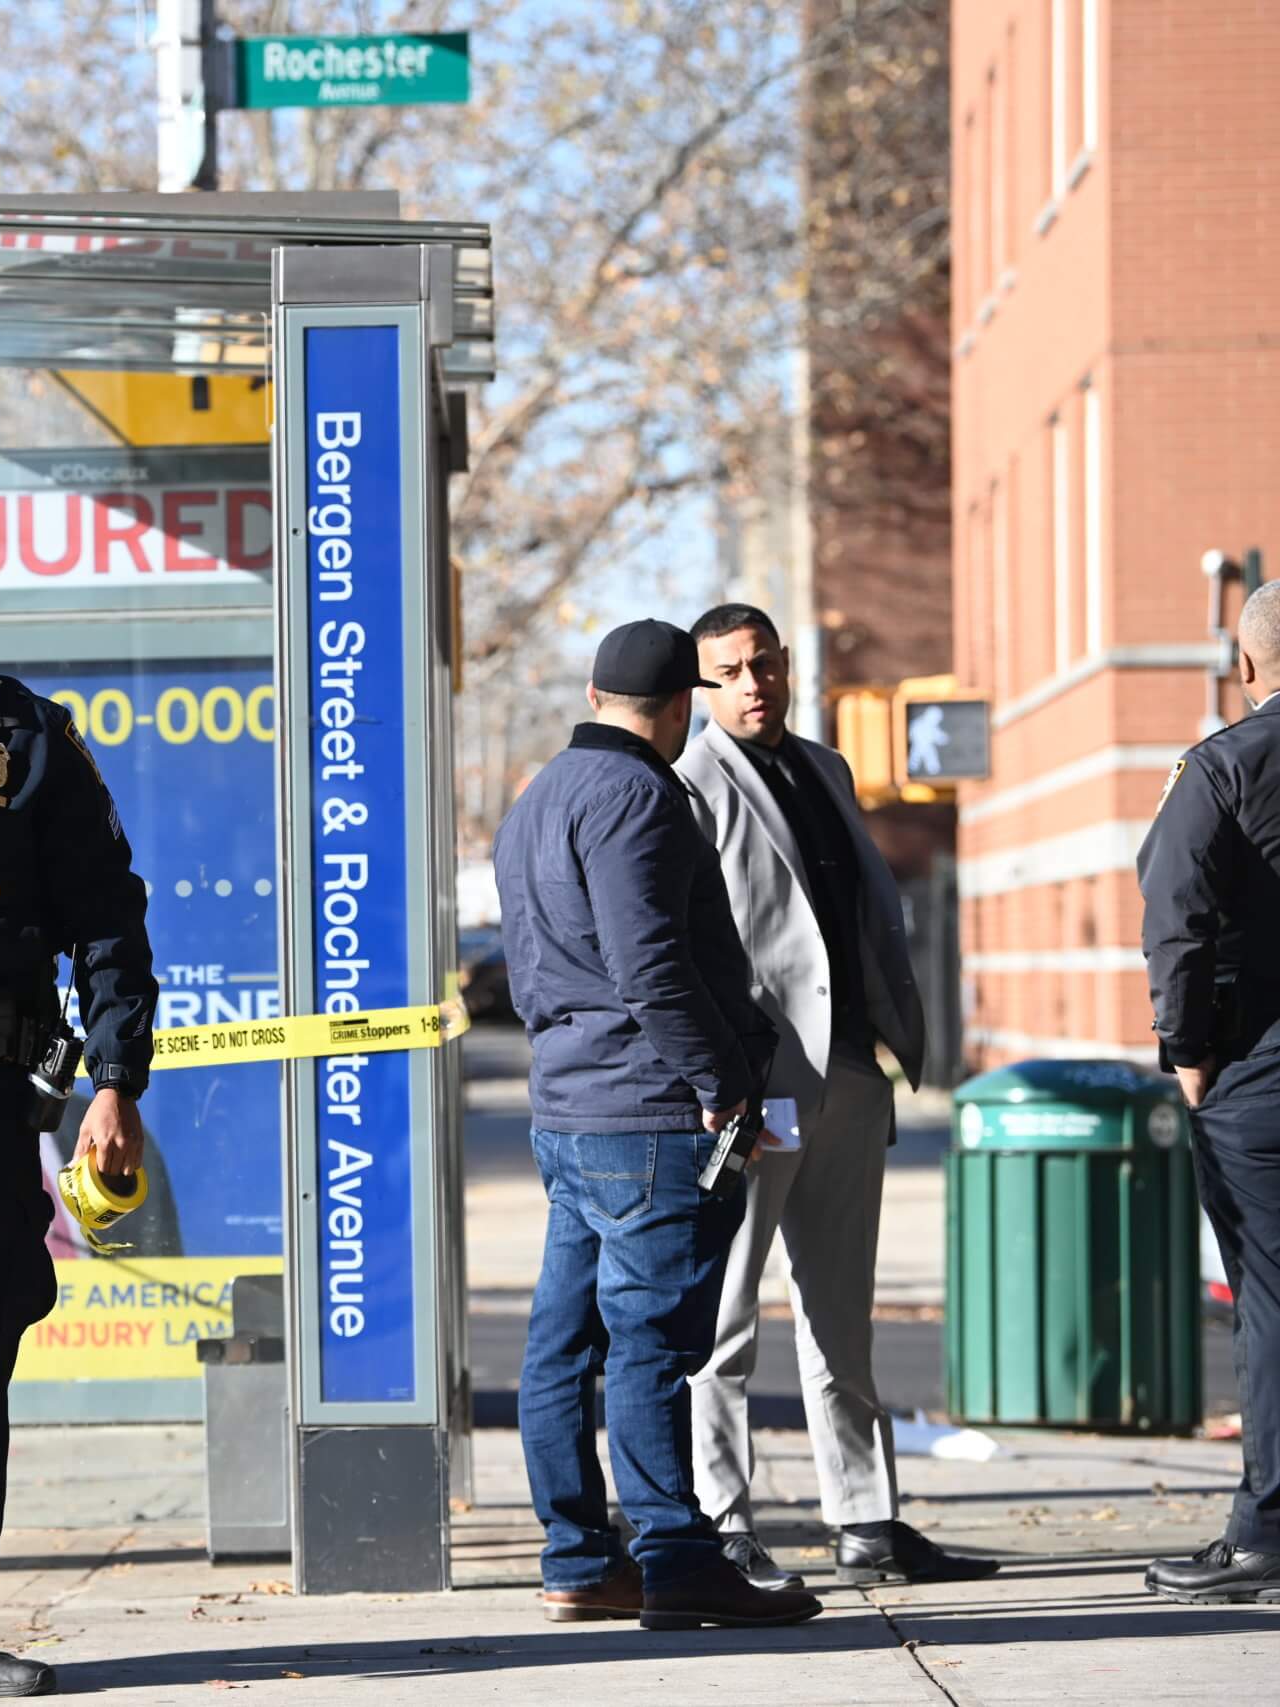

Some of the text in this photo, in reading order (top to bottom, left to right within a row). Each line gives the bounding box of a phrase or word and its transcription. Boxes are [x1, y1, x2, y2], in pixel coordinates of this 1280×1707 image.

[263, 40, 434, 81] Rochester
[308, 411, 374, 1338] Bergen Street & Rocheter Avenue
[166, 964, 225, 985] THE
[167, 1034, 200, 1054] SCENE
[212, 1032, 226, 1049] DO
[229, 1030, 248, 1048] NOT
[251, 1027, 286, 1046] CROSS
[421, 1015, 441, 1033] 1-8
[86, 1282, 234, 1309] AMERICA
[35, 1321, 154, 1348] INJURY
